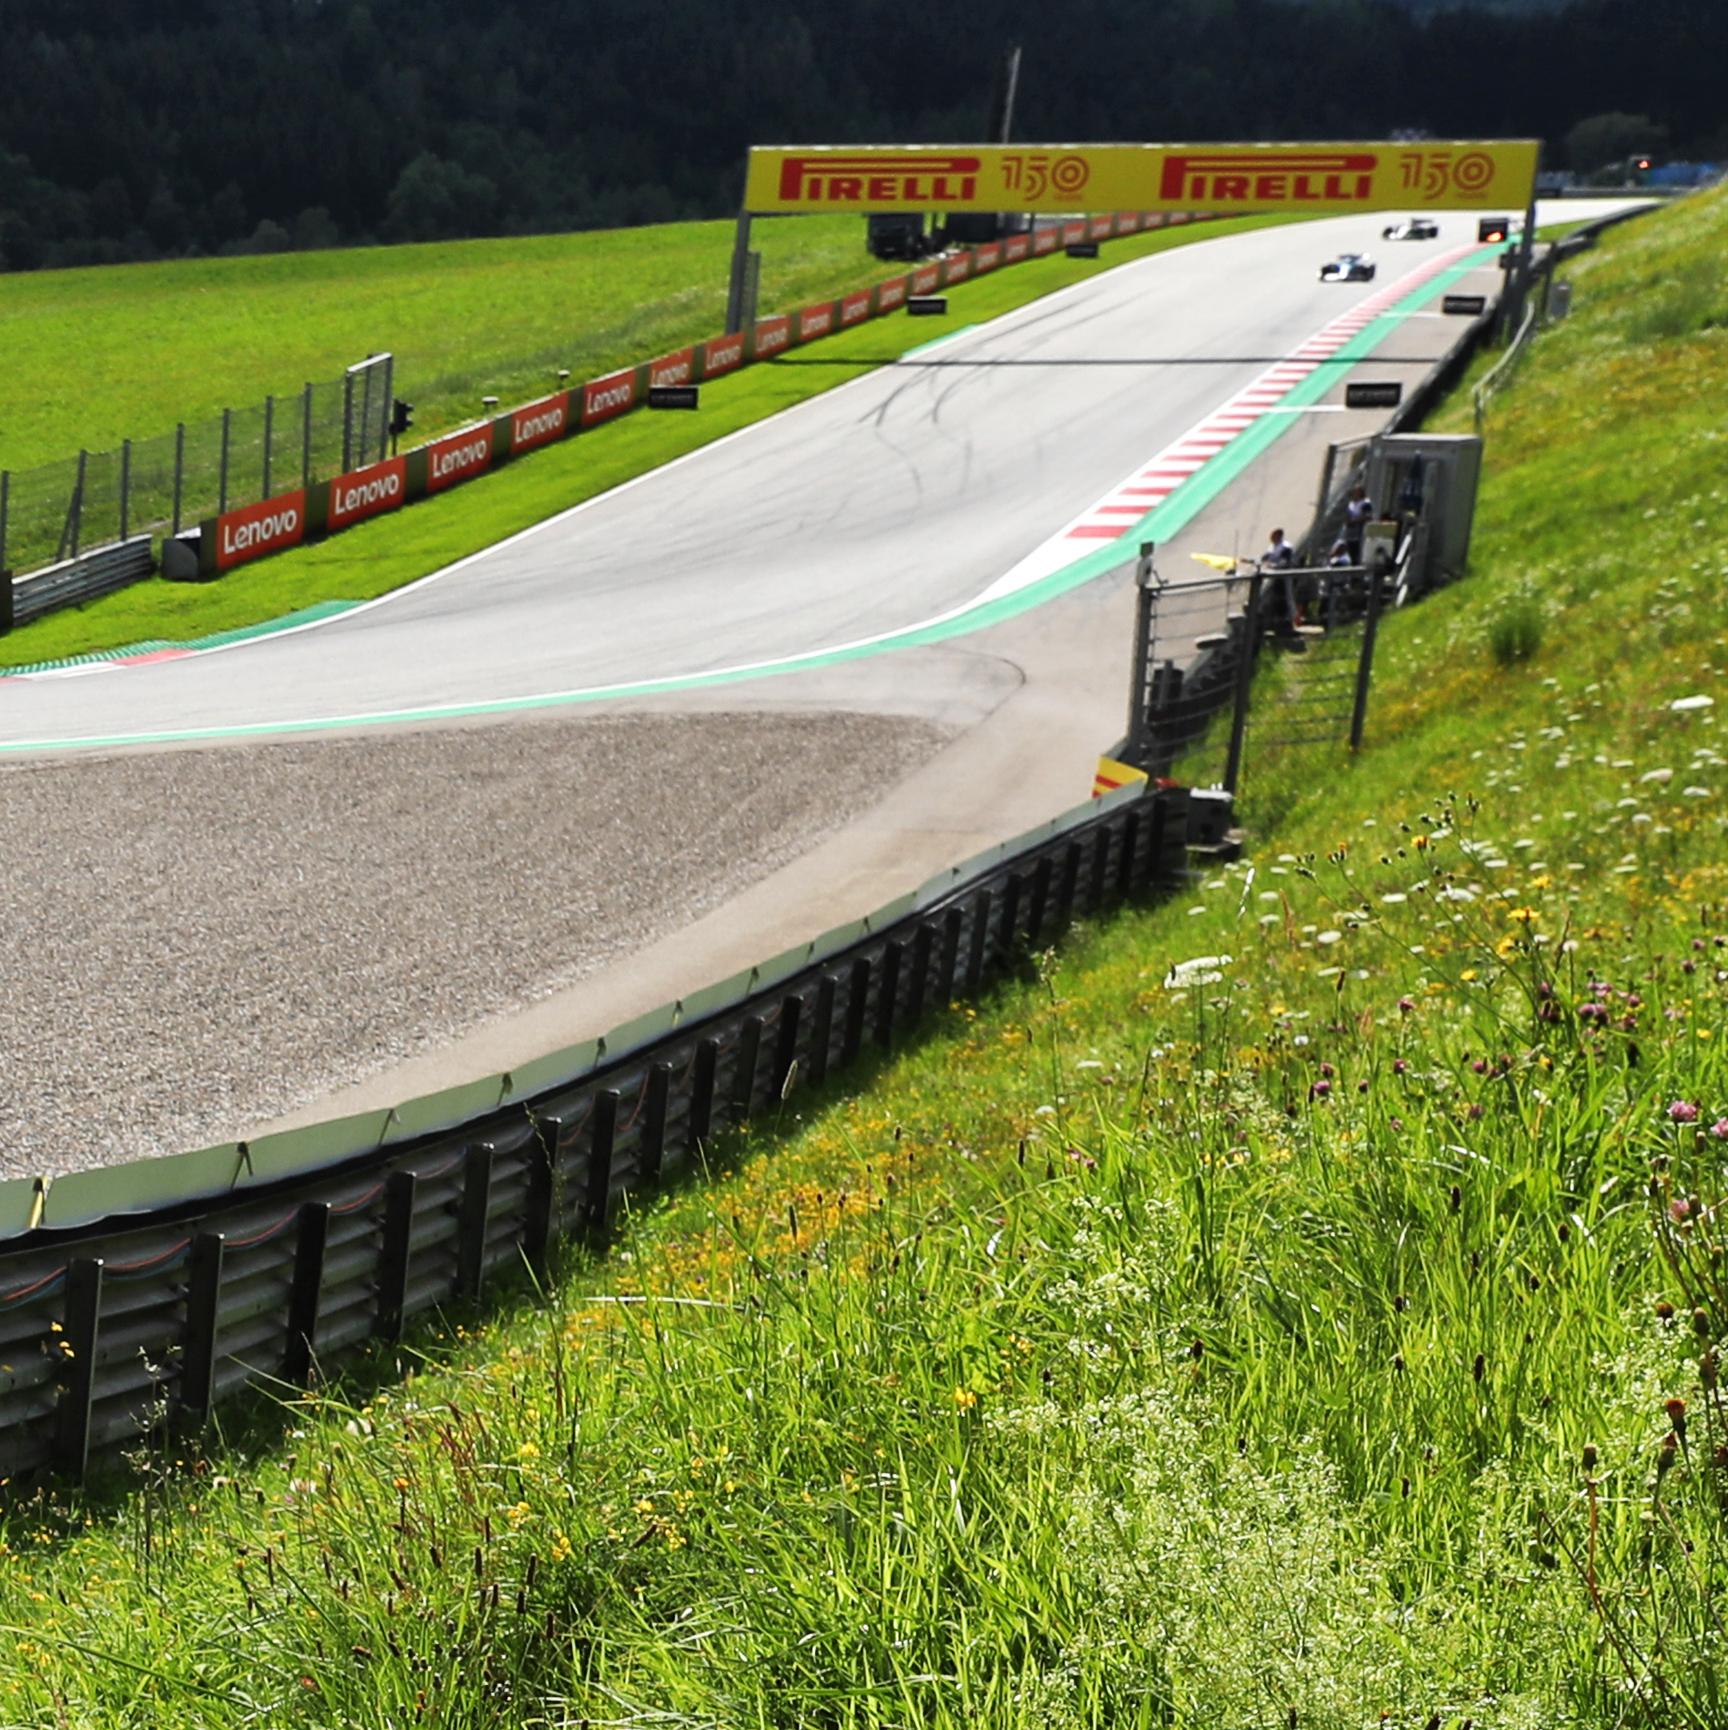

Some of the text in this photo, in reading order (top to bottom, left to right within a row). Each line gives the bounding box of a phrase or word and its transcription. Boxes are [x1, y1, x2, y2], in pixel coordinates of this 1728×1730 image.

[779, 155, 1089, 201] PIRELLI 150
[1160, 153, 1495, 199] PIRELLI 150
[587, 384, 631, 414] Lenovo
[515, 408, 562, 444] Lenovo
[433, 440, 486, 478] Lenovo
[334, 474, 399, 515] Lenovo
[224, 509, 297, 554] Lenovo
